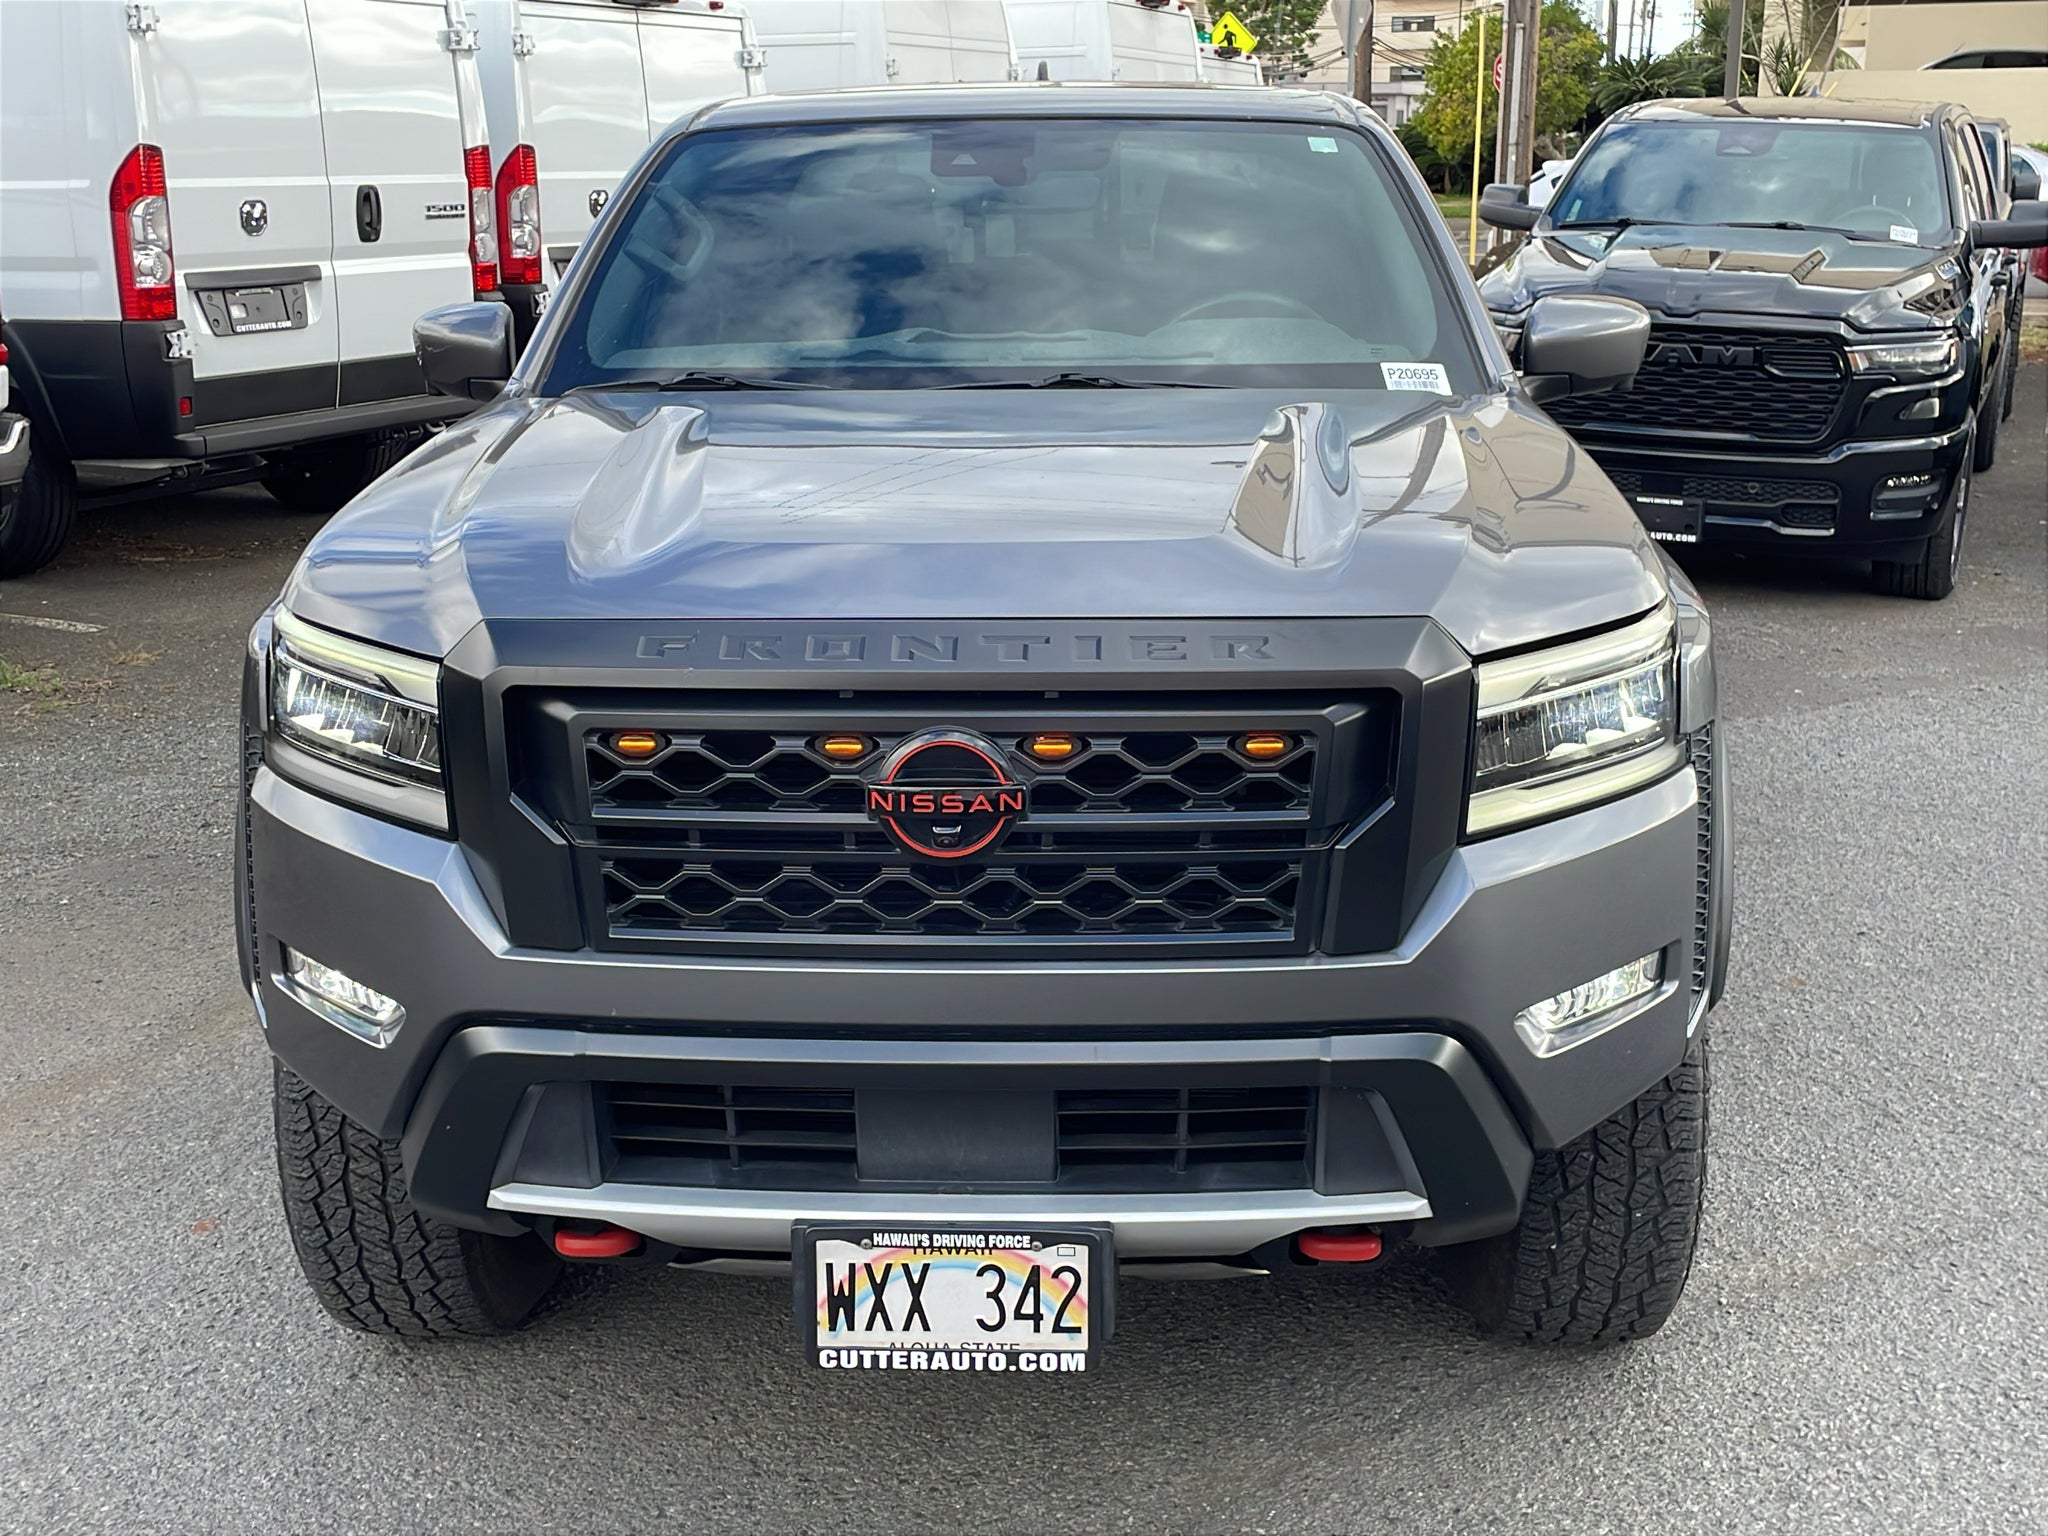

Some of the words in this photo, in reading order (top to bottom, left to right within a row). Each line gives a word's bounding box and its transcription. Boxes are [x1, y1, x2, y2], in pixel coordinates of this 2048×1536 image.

[425, 204, 465, 212] 1500
[1647, 343, 1754, 366] AM
[1387, 368, 1439, 381] P20695
[1649, 531, 1697, 543] AUTO.COM
[636, 634, 1276, 662] FRONTIER
[870, 790, 1023, 813] NISSAN
[872, 1233, 930, 1247] HAWAII'S
[932, 1234, 986, 1248] DRIVING
[988, 1235, 1031, 1249] FORCE
[825, 1262, 931, 1332] WXX
[975, 1263, 1082, 1334] 342
[818, 1349, 1086, 1372] CUTTERAUTO.COM
